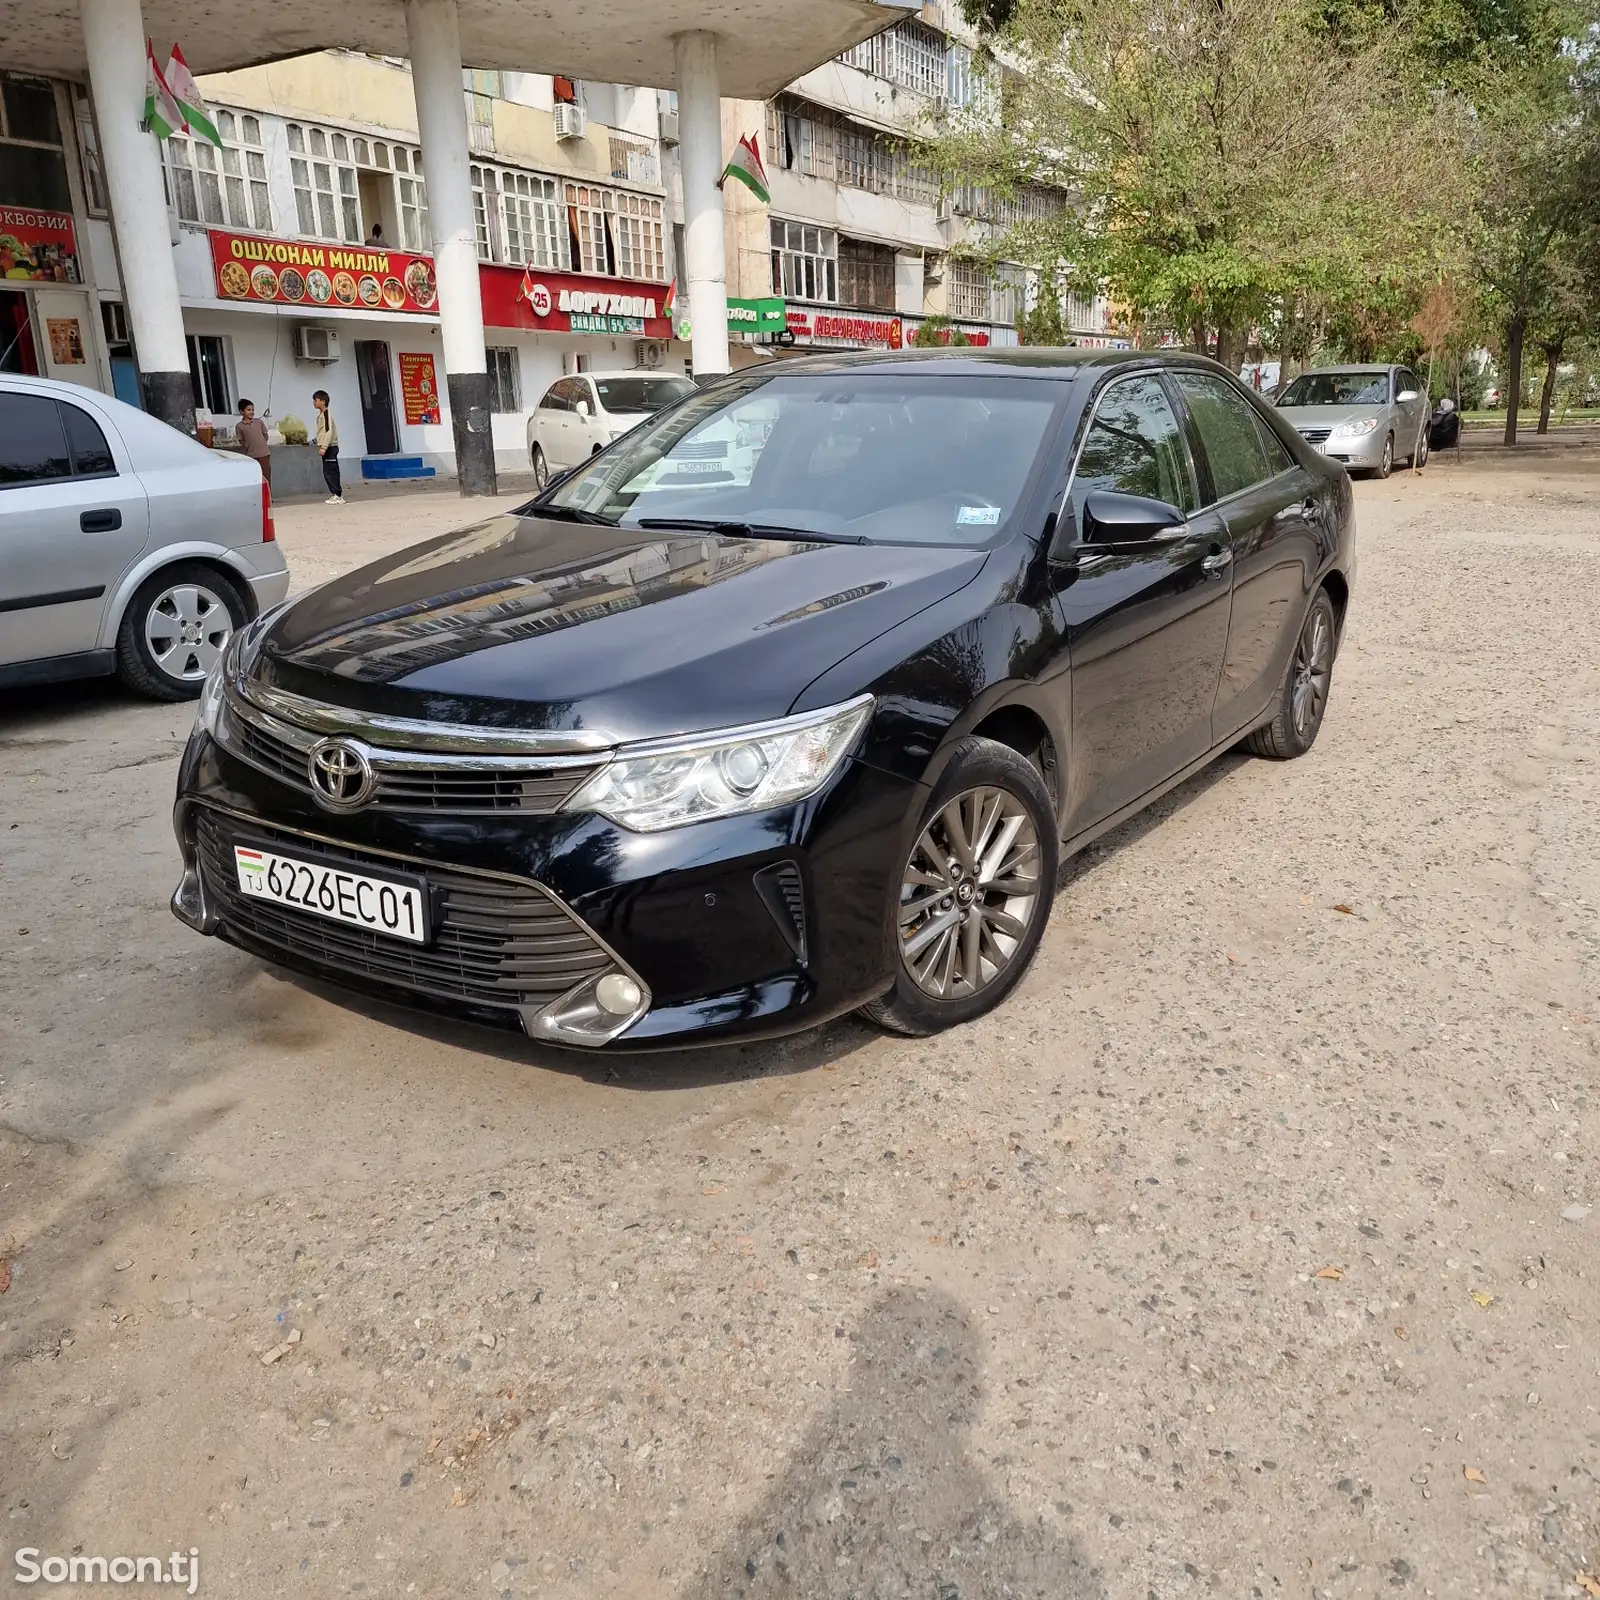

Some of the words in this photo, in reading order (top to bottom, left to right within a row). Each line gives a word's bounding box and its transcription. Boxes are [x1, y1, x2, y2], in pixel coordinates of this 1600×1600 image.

[0, 212, 68, 230] КВОРИИ
[231, 239, 325, 267] ОШХОНАИ
[535, 292, 548, 309] 25
[571, 314, 607, 332] СКИДКА
[246, 874, 263, 892] TJ
[267, 858, 415, 934] 6226EC01
